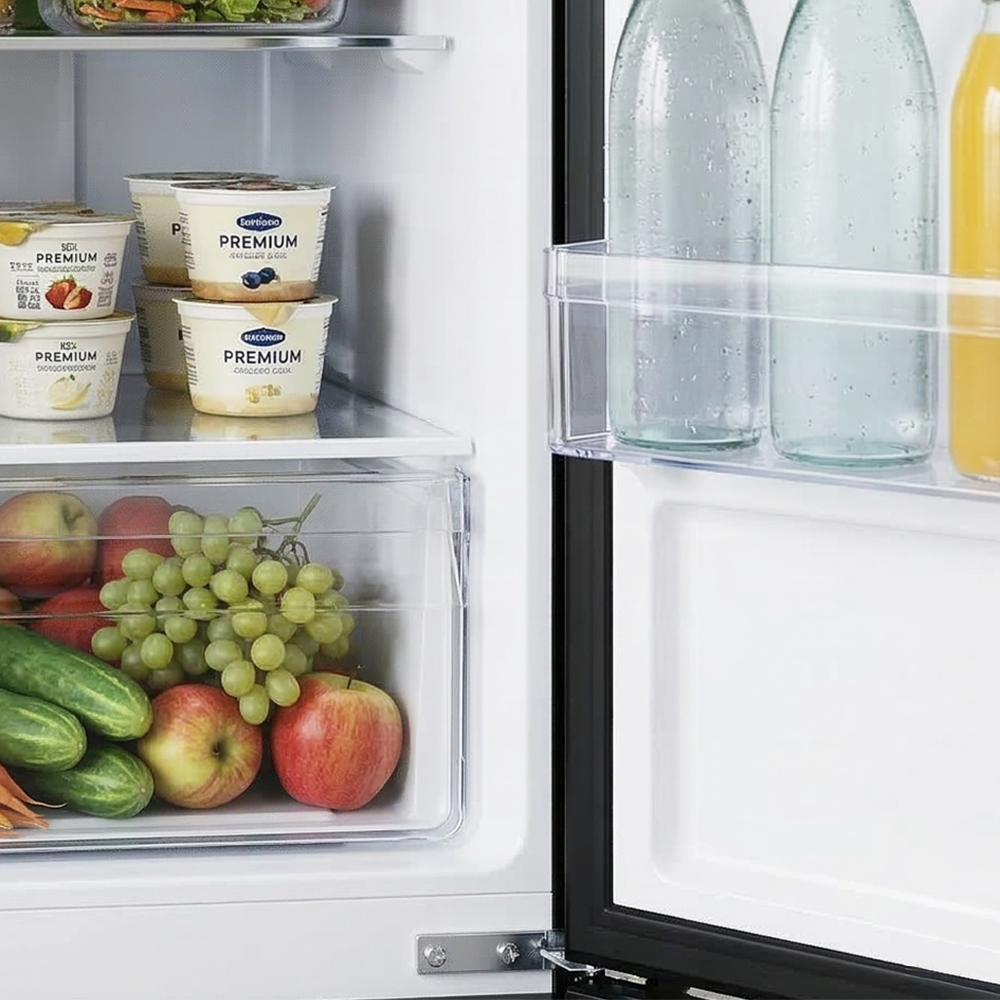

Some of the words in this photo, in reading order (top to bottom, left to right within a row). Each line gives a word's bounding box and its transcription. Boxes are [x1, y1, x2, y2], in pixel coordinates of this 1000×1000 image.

[219, 234, 298, 249] PREMIUM
[36, 252, 98, 264] PREMIUM
[35, 350, 97, 362] PREMIUM
[223, 349, 302, 364] PREMIUM
